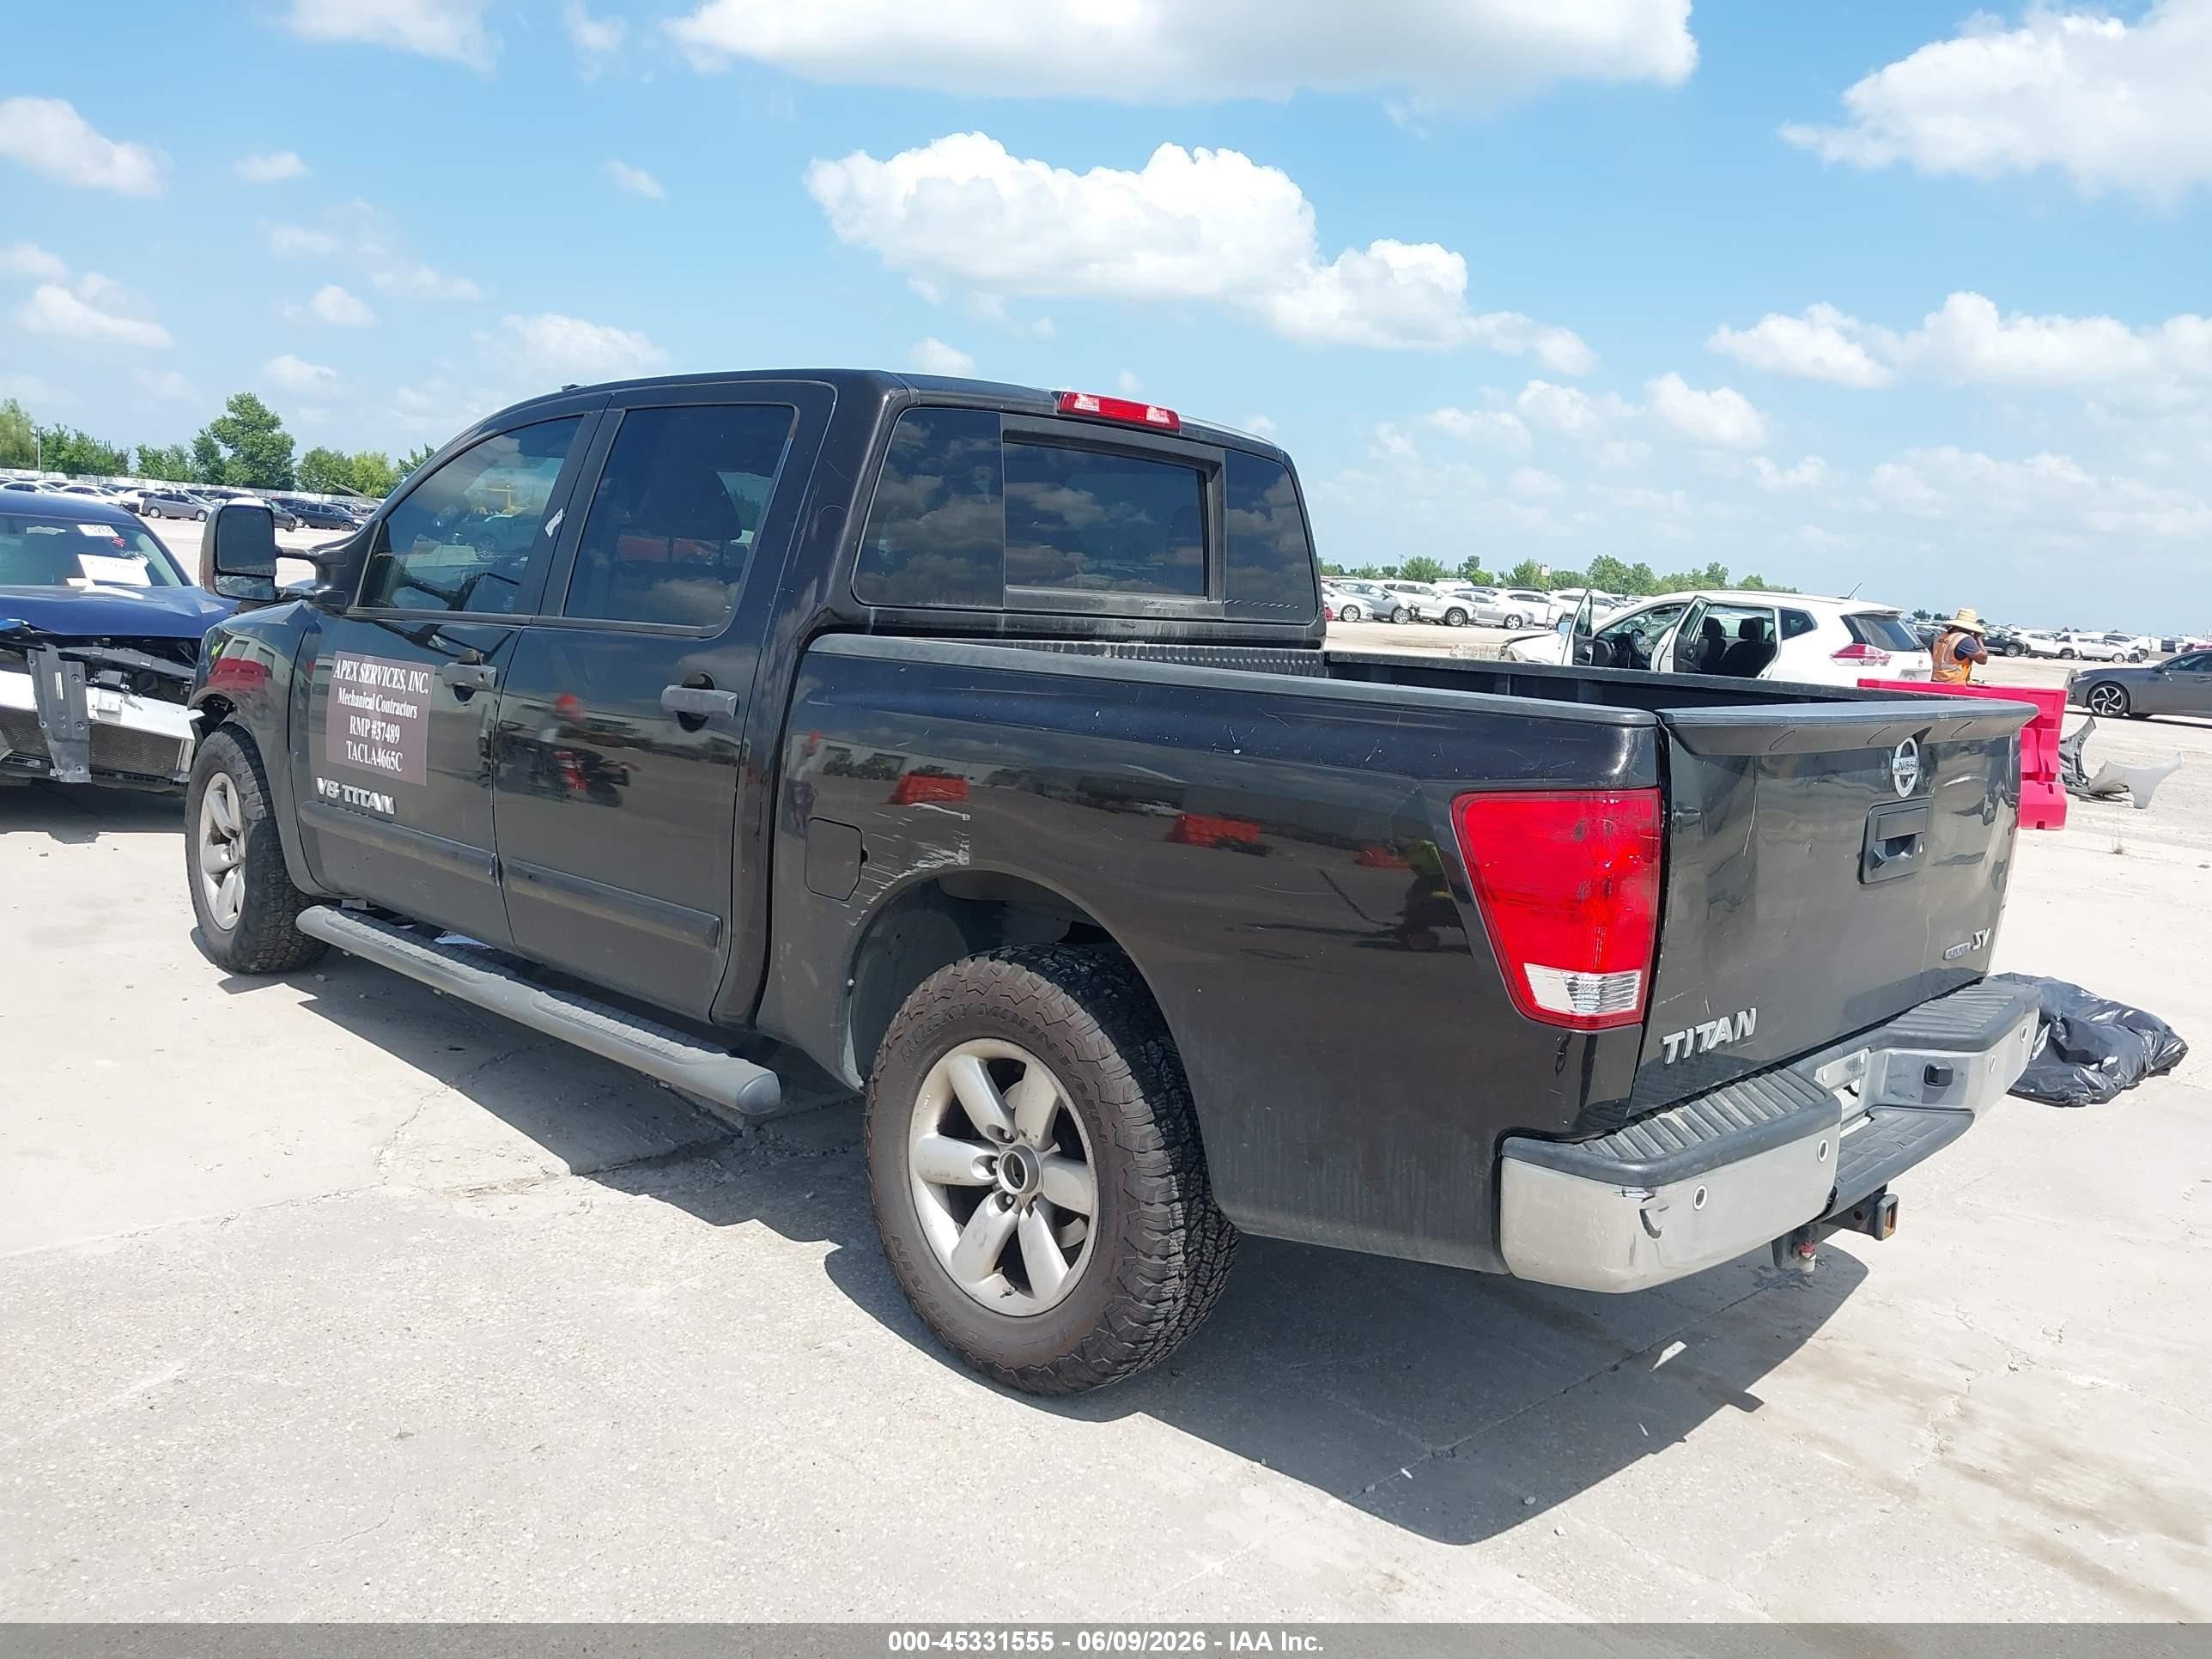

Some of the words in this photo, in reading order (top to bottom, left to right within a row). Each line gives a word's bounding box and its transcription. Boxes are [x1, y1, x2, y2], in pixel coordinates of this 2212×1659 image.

[333, 659, 360, 682] APEX
[359, 663, 407, 695] SERVICES,
[408, 671, 429, 695] INC.
[337, 687, 375, 711] Mechanical
[375, 694, 418, 720] Contractors
[349, 715, 371, 738] RMP
[371, 720, 400, 744] #37489
[346, 740, 404, 772] TACLA4665C
[316, 776, 339, 799] V8
[342, 784, 396, 815] TITAN
[1972, 927, 1990, 951] SV
[1662, 1006, 1757, 1065] TITAN
